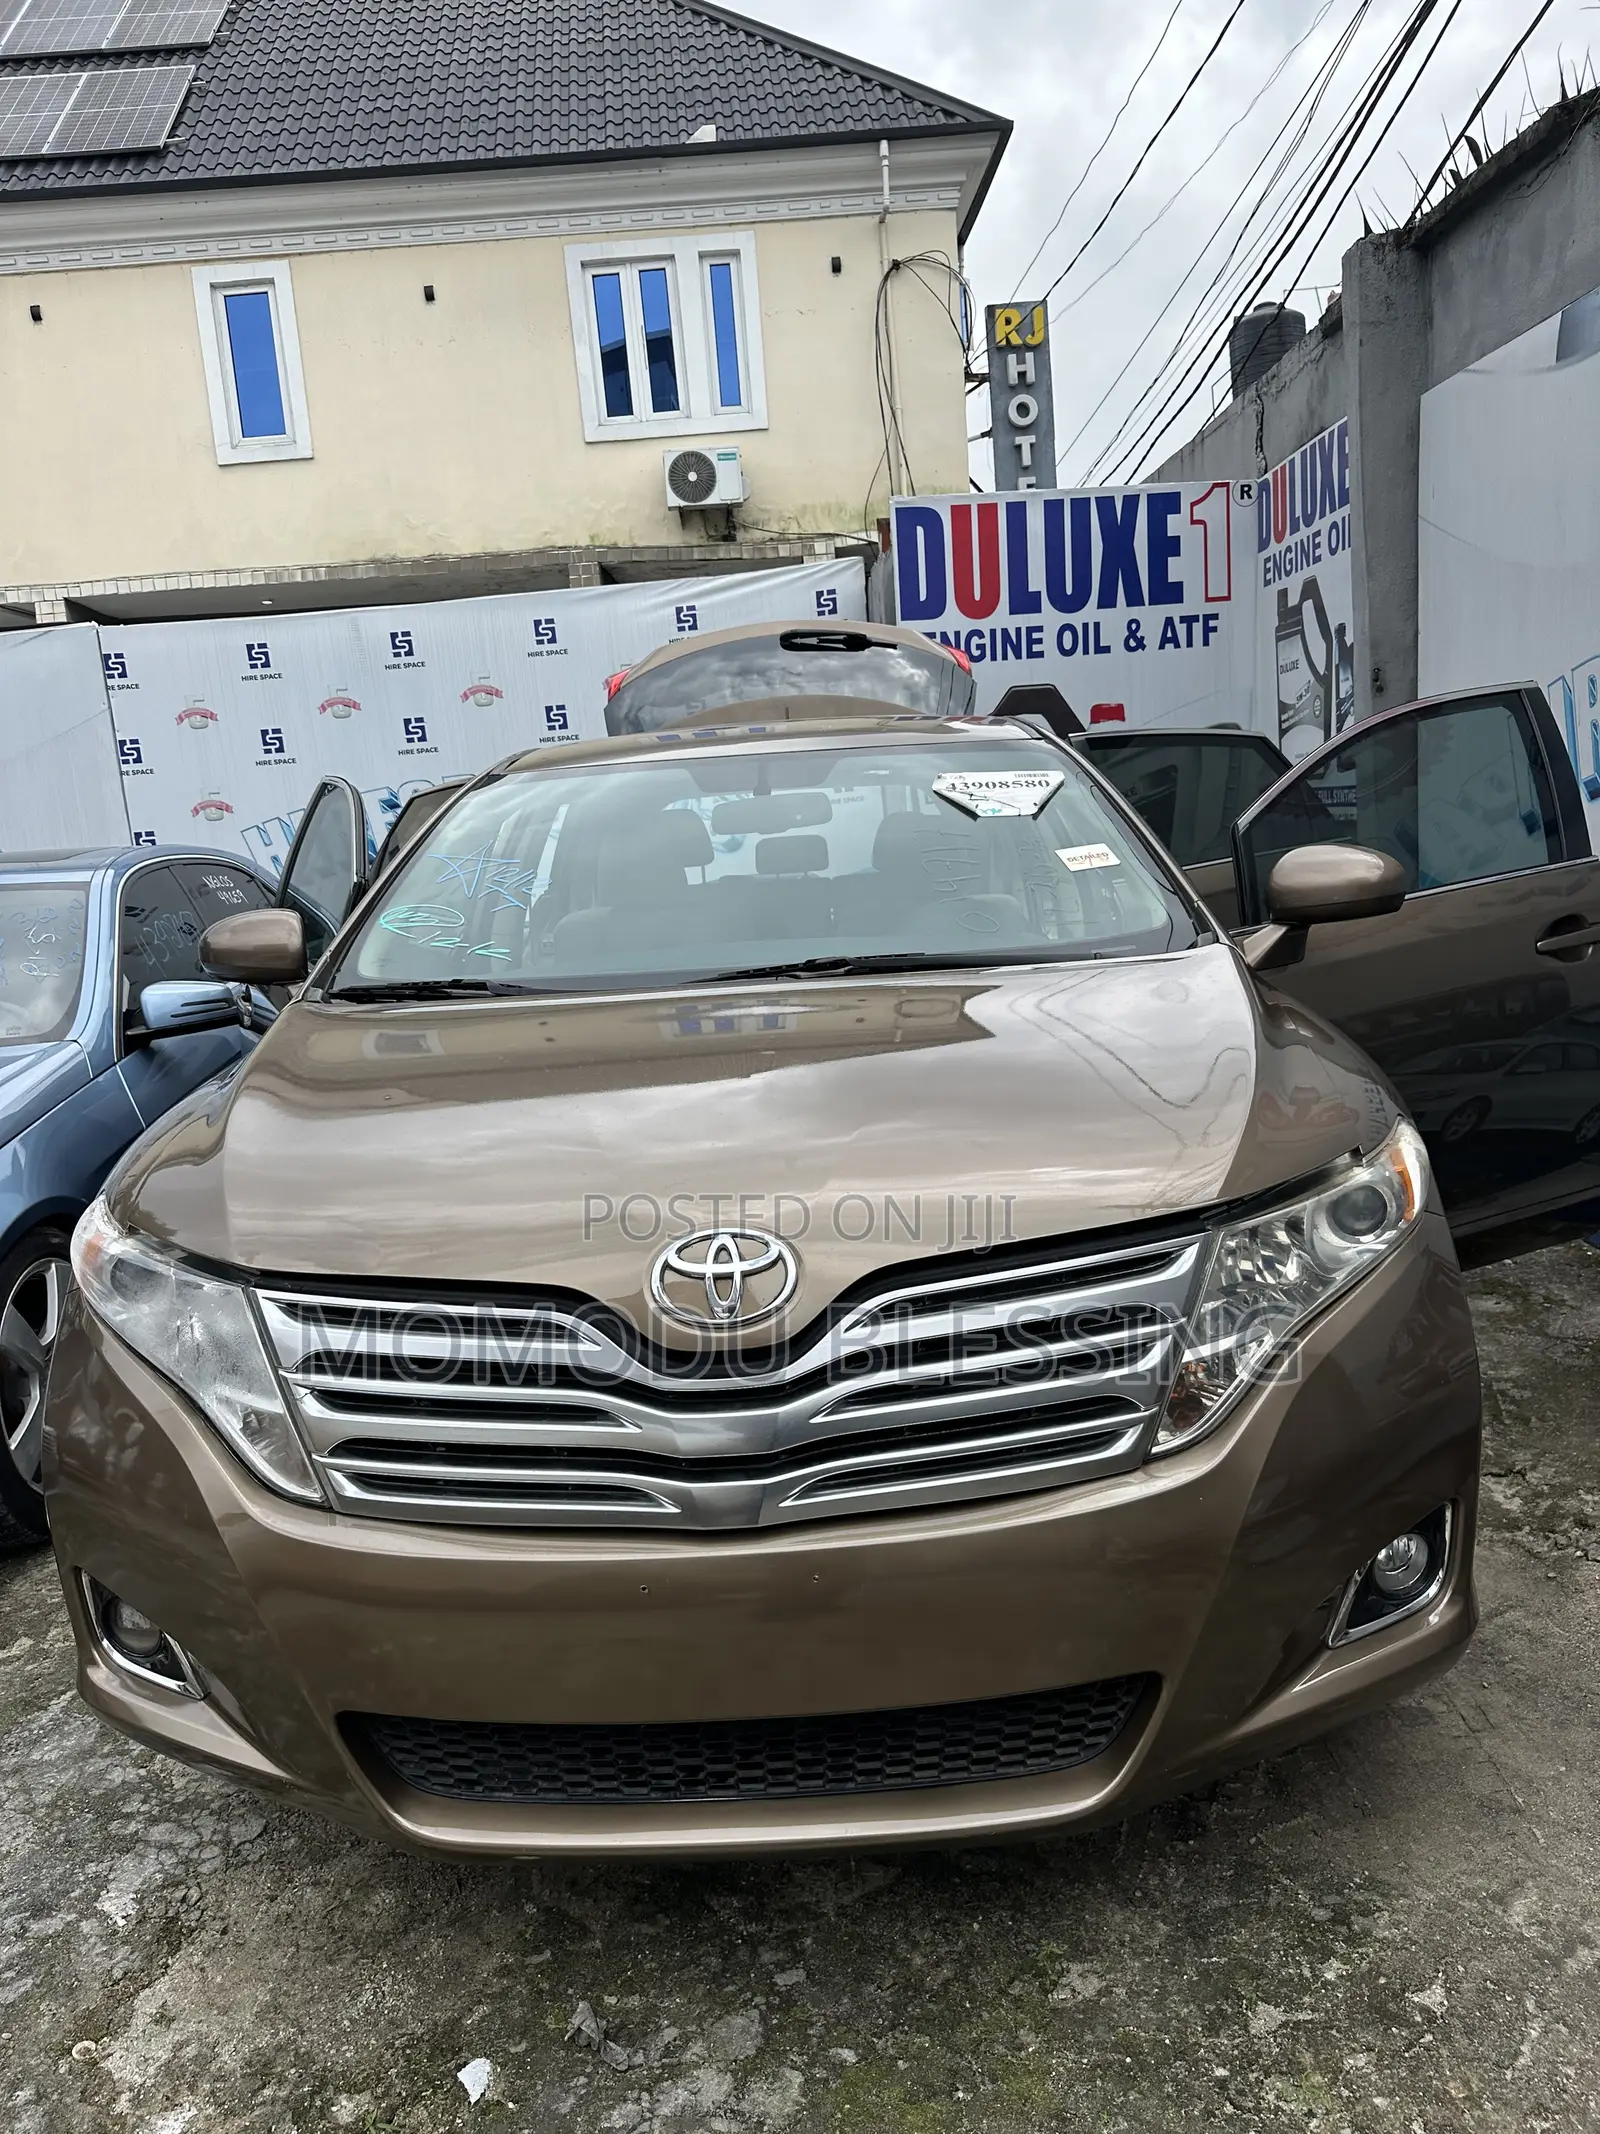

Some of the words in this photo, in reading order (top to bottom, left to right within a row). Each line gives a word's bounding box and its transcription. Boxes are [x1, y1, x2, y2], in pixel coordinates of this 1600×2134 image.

[995, 306, 1045, 347] RJ
[1258, 421, 1349, 554] DULUXE
[1263, 529, 1321, 587] ENGINE
[922, 626, 1044, 663] NGINE
[1056, 621, 1111, 657] OIL
[1124, 618, 1146, 652] &
[1158, 613, 1219, 650] ATF
[403, 661, 426, 669] SPACE
[1280, 659, 1299, 674] DULUXE
[557, 734, 580, 742] SPACE
